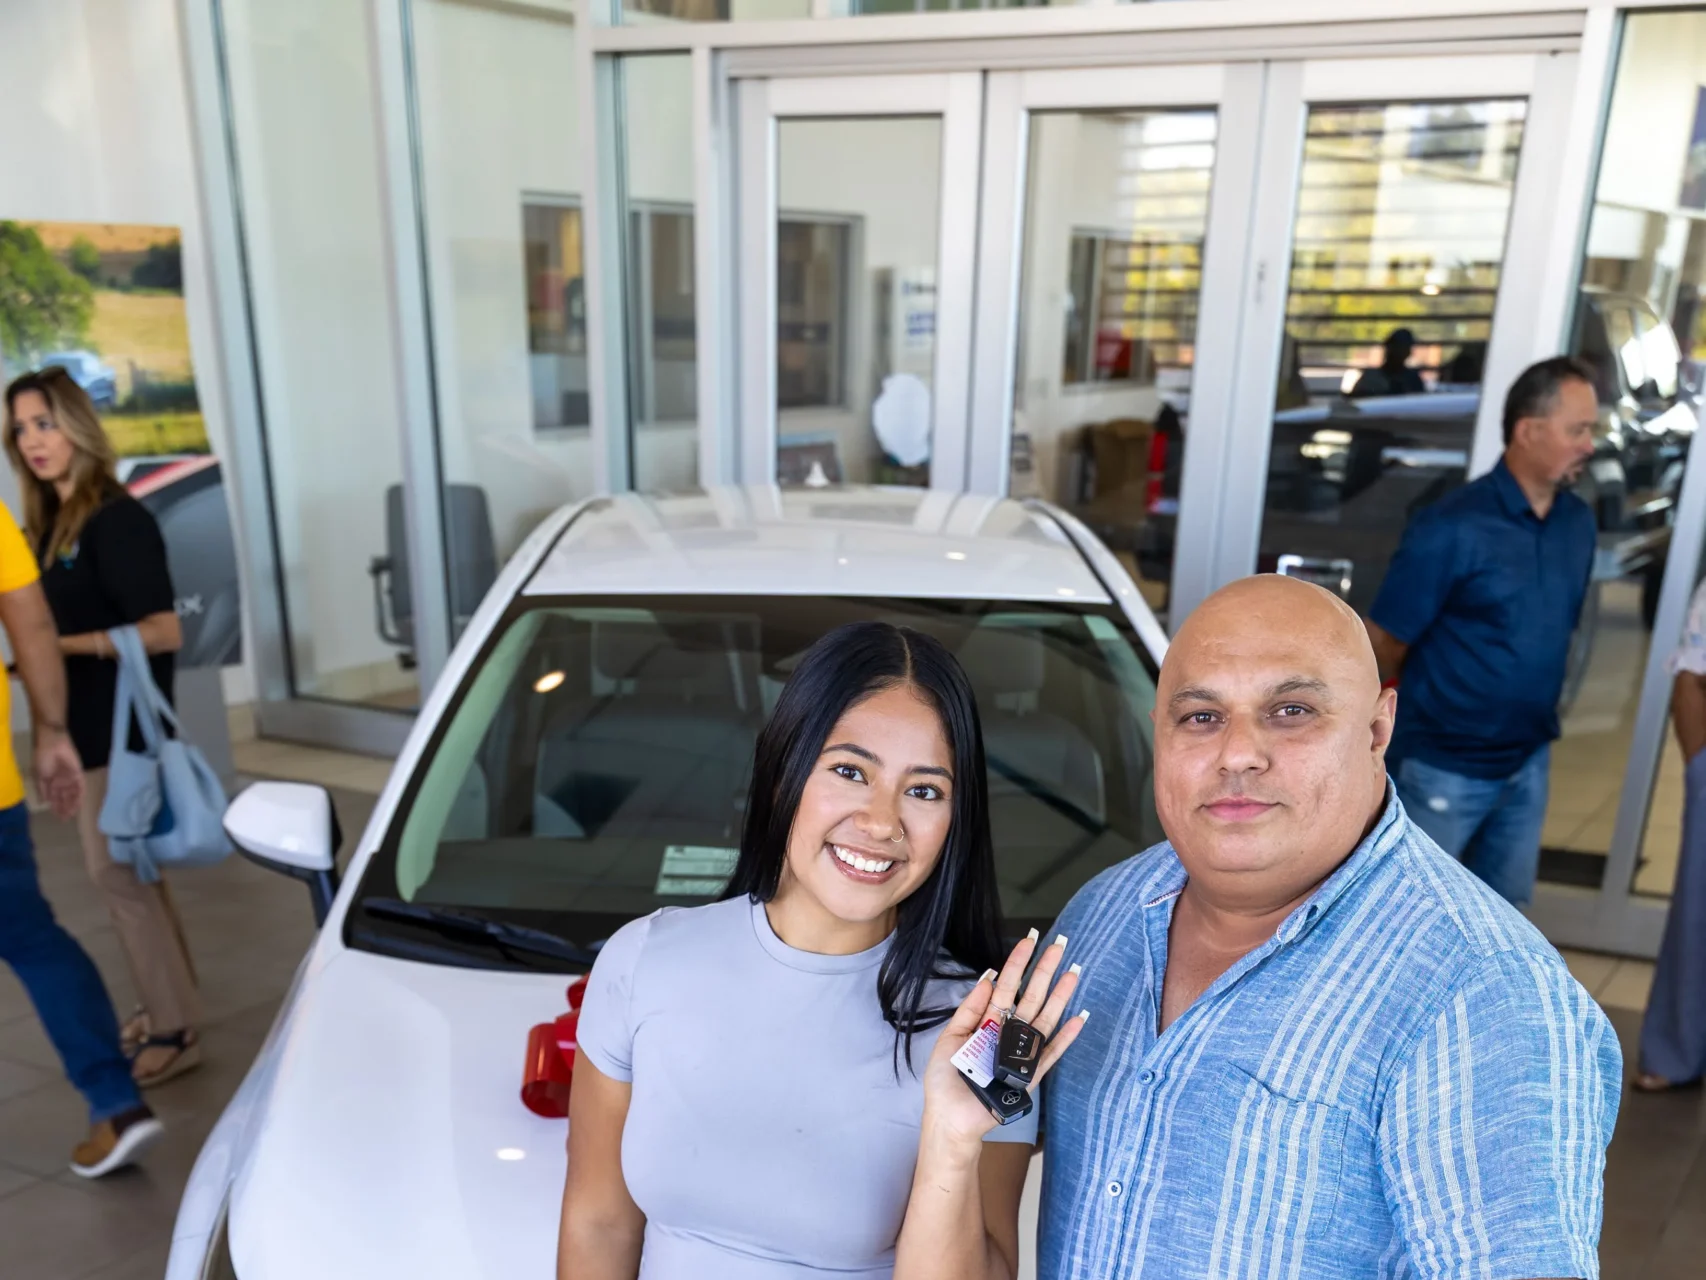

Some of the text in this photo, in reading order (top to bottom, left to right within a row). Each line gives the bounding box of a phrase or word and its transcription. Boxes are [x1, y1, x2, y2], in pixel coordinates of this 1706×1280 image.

[973, 1039, 985, 1051] MODEL
[977, 1035, 987, 1045] MAKE
[969, 1043, 981, 1055] COLOR
